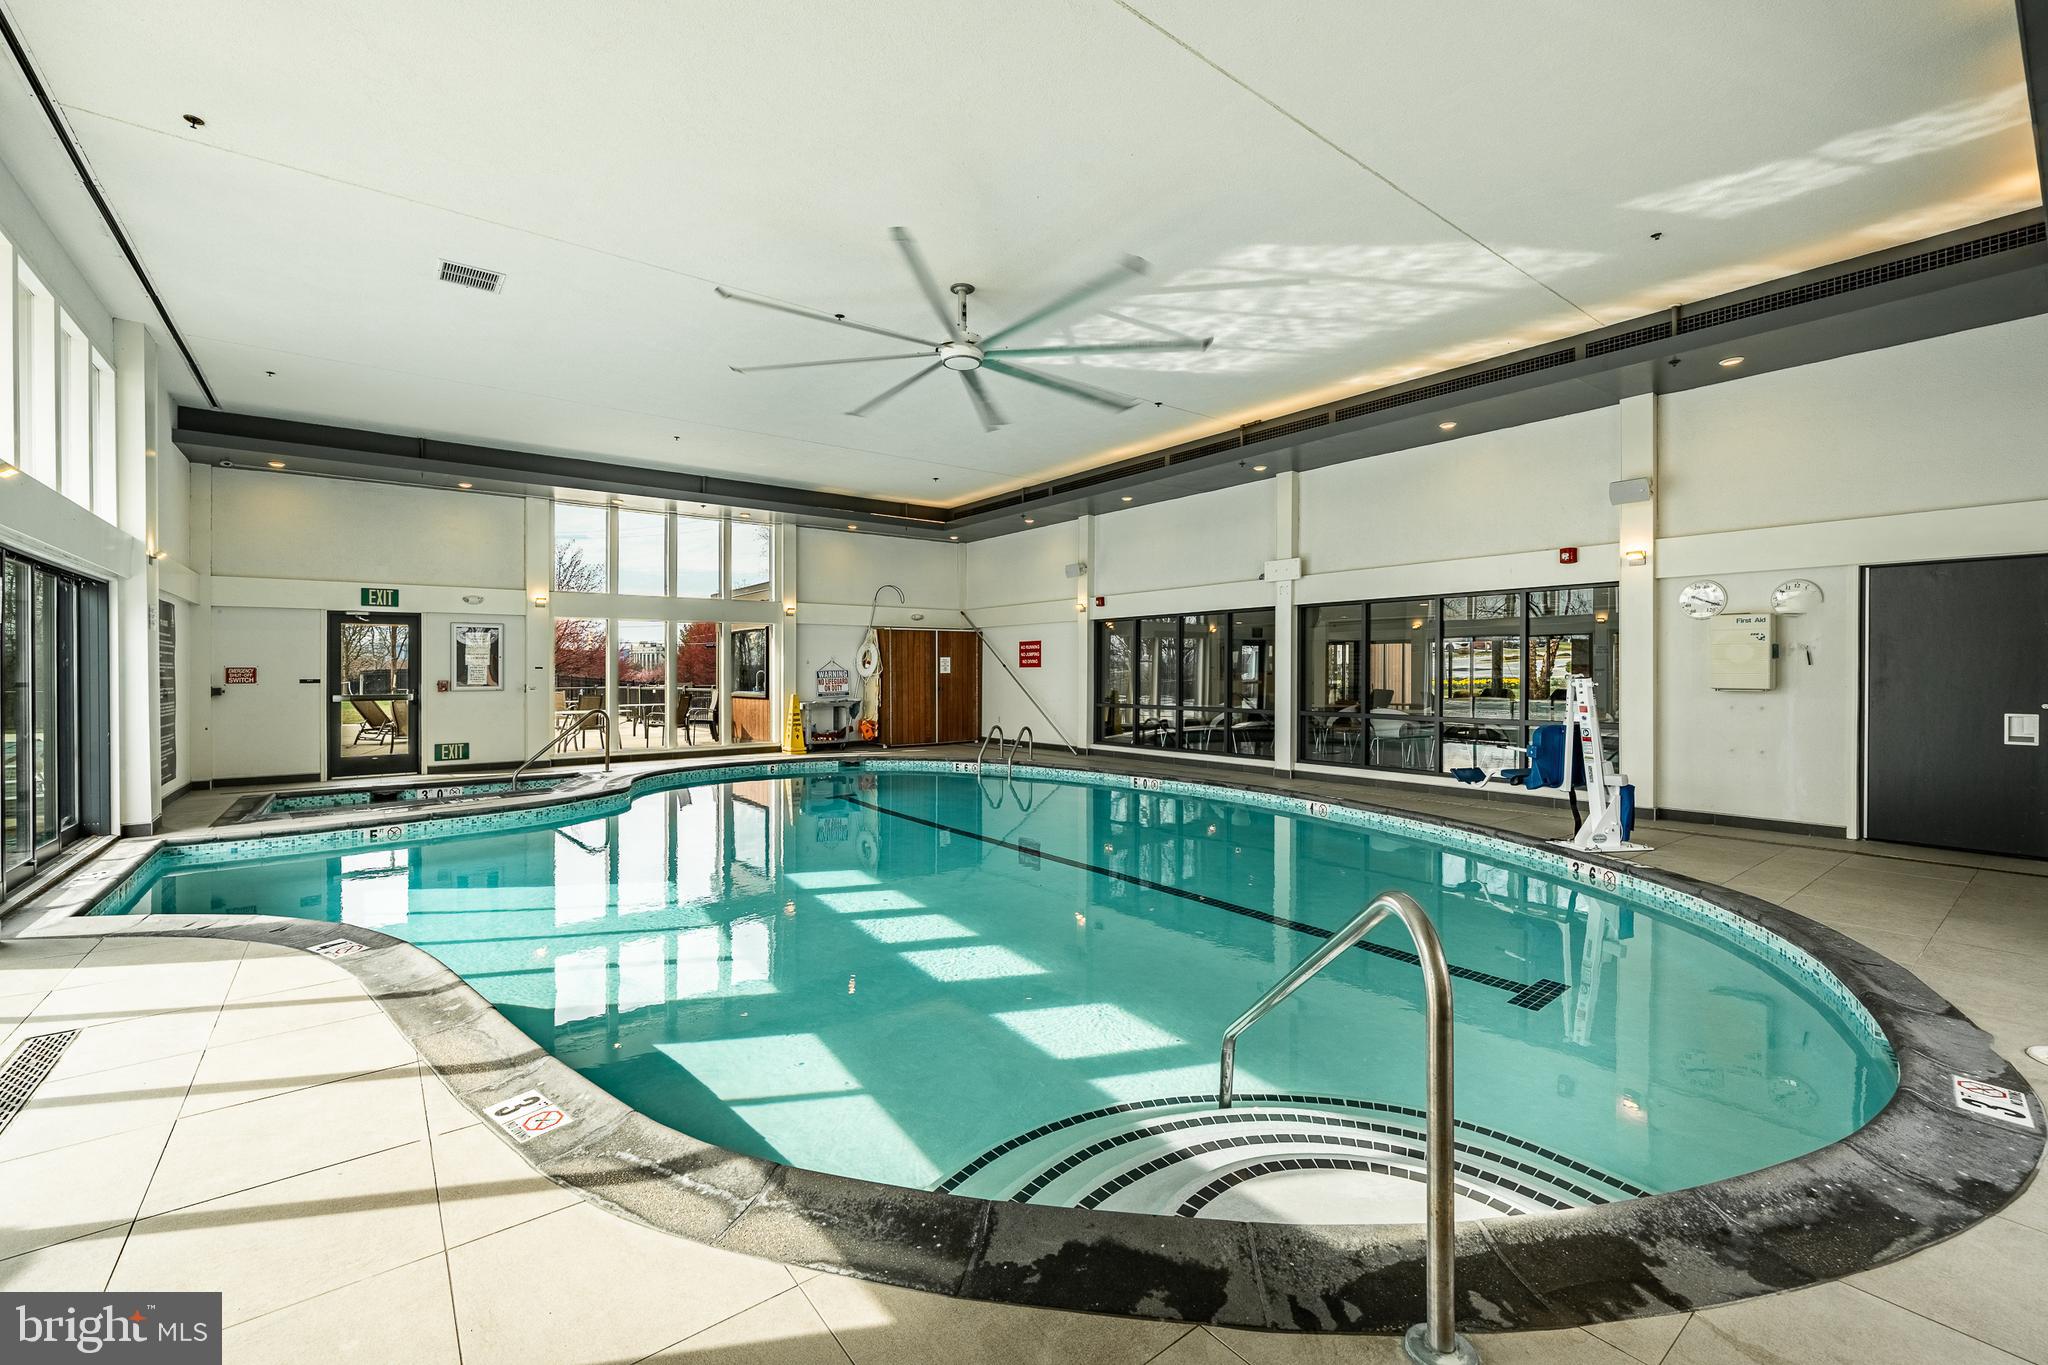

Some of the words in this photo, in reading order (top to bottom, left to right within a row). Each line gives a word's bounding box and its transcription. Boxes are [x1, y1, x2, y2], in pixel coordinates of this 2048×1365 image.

[369, 589, 394, 606] EXIT
[818, 670, 848, 679] WARNING
[825, 677, 849, 686] LIFEGUARD
[832, 684, 843, 692] DUTY
[441, 743, 465, 760] EXIT
[1572, 861, 1580, 881] 3
[1589, 866, 1596, 886] 6
[494, 1096, 541, 1117] 3
[1961, 1097, 2027, 1119] 3
